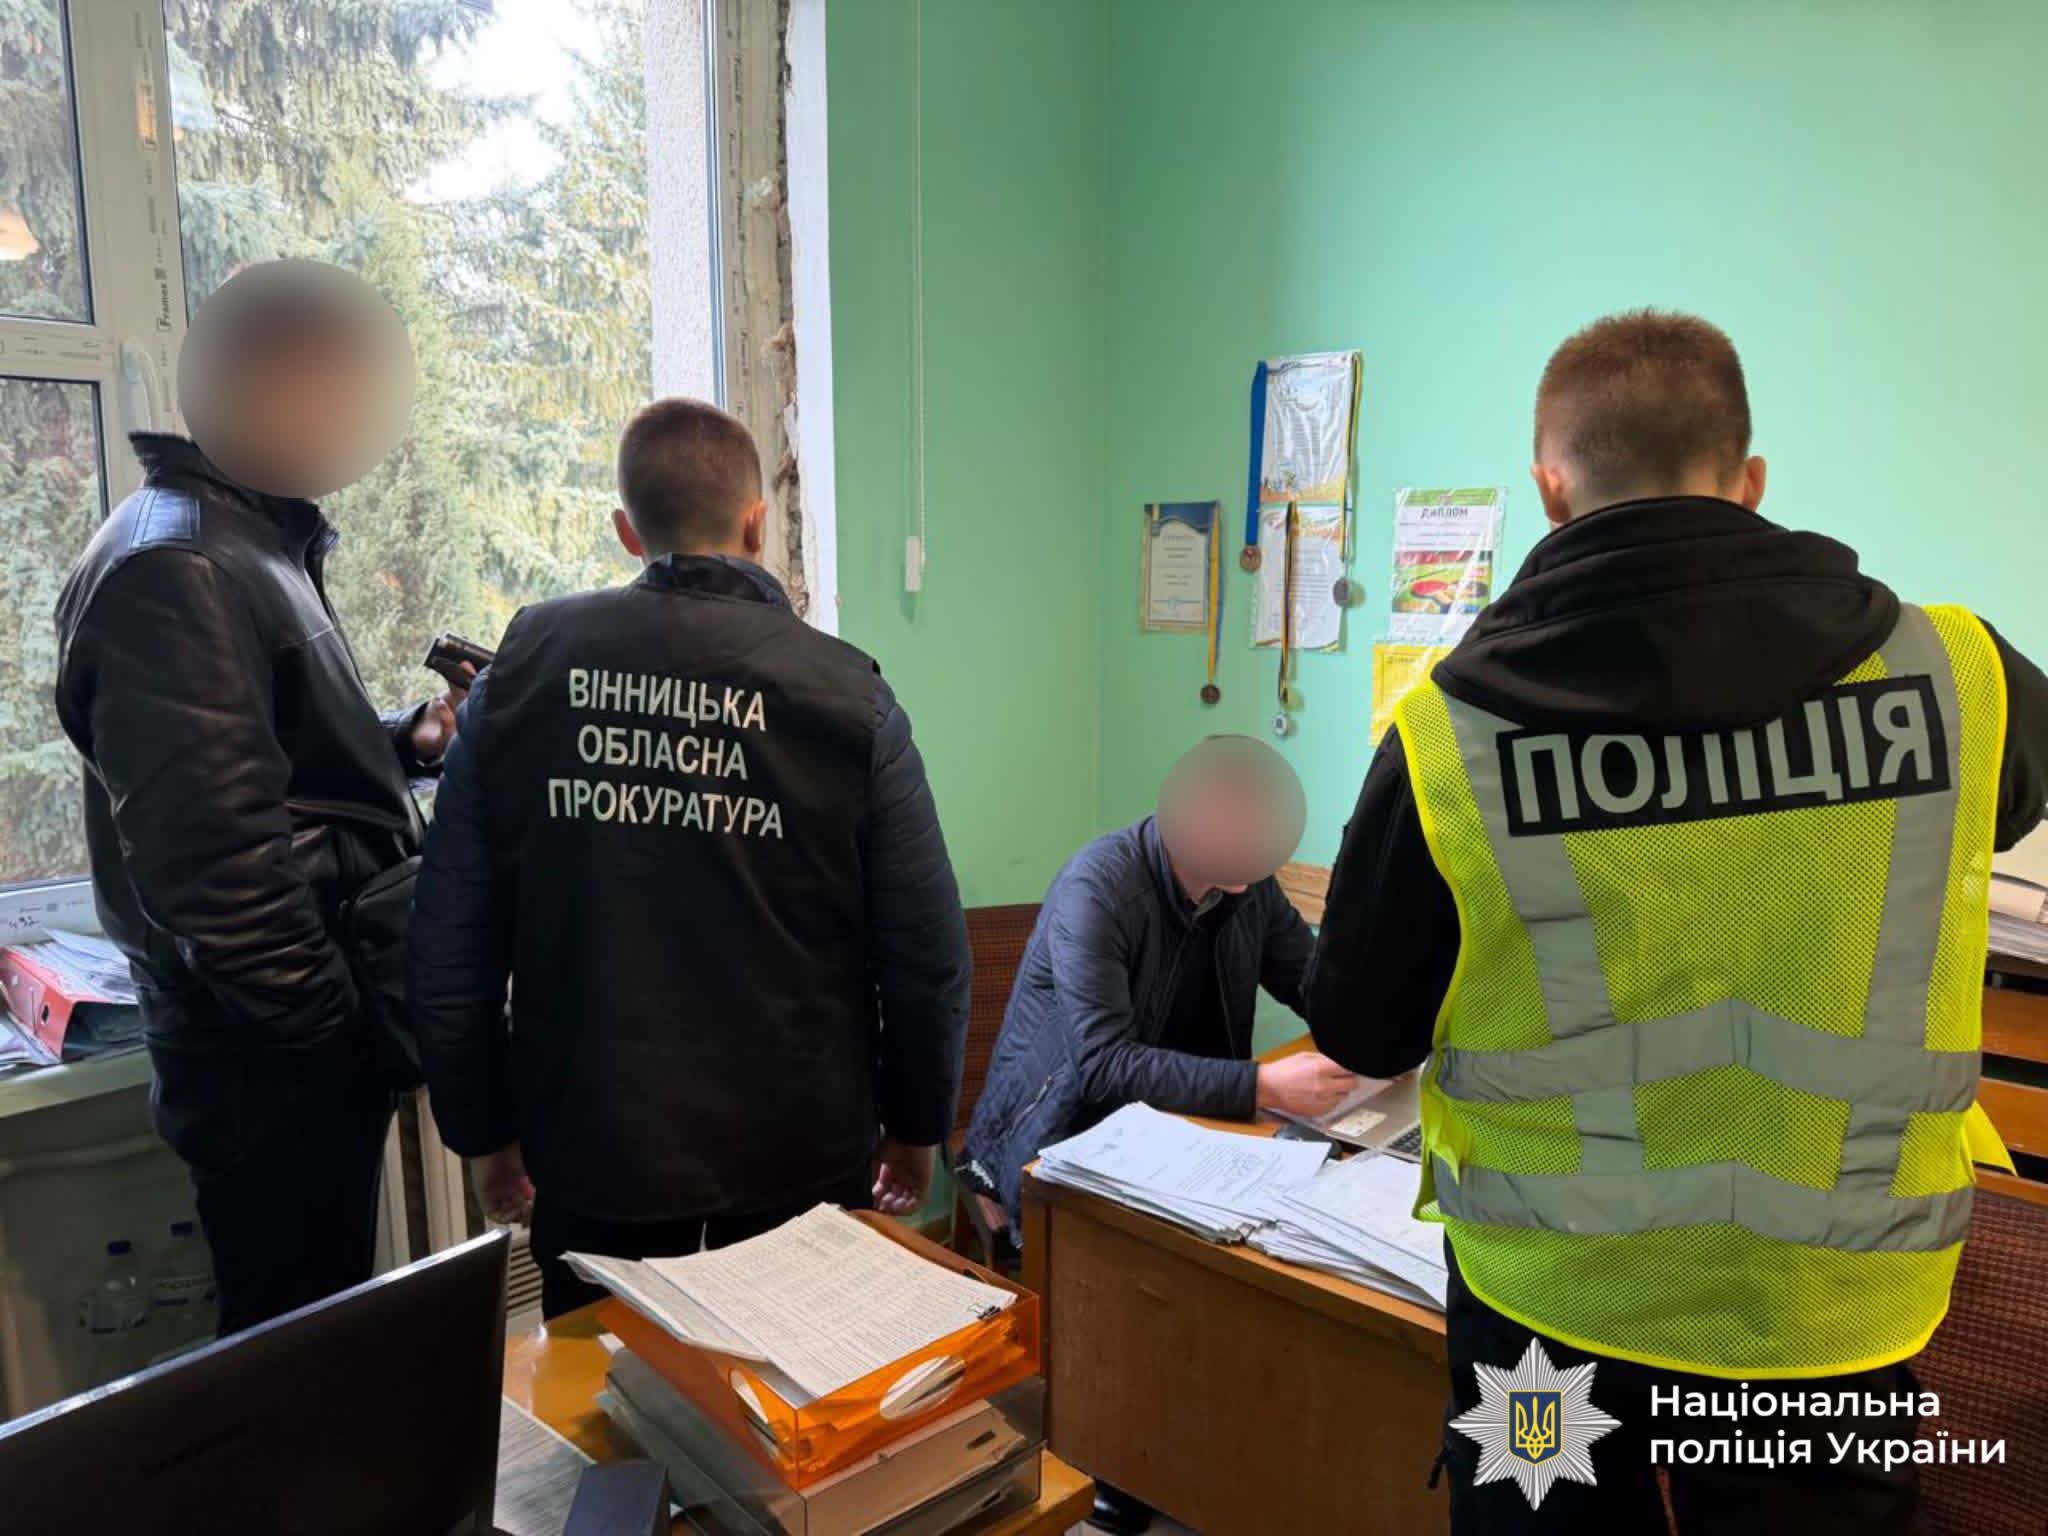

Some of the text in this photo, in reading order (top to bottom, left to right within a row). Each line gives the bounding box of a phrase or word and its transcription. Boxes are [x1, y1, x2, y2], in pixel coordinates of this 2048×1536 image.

[569, 668, 766, 731] ВІННИЦЬКА
[577, 724, 748, 780] ОБЛАСНА
[1512, 689, 1932, 823] ПОЛІЦІЯ
[548, 778, 783, 838] ПРОКУРАТУРА
